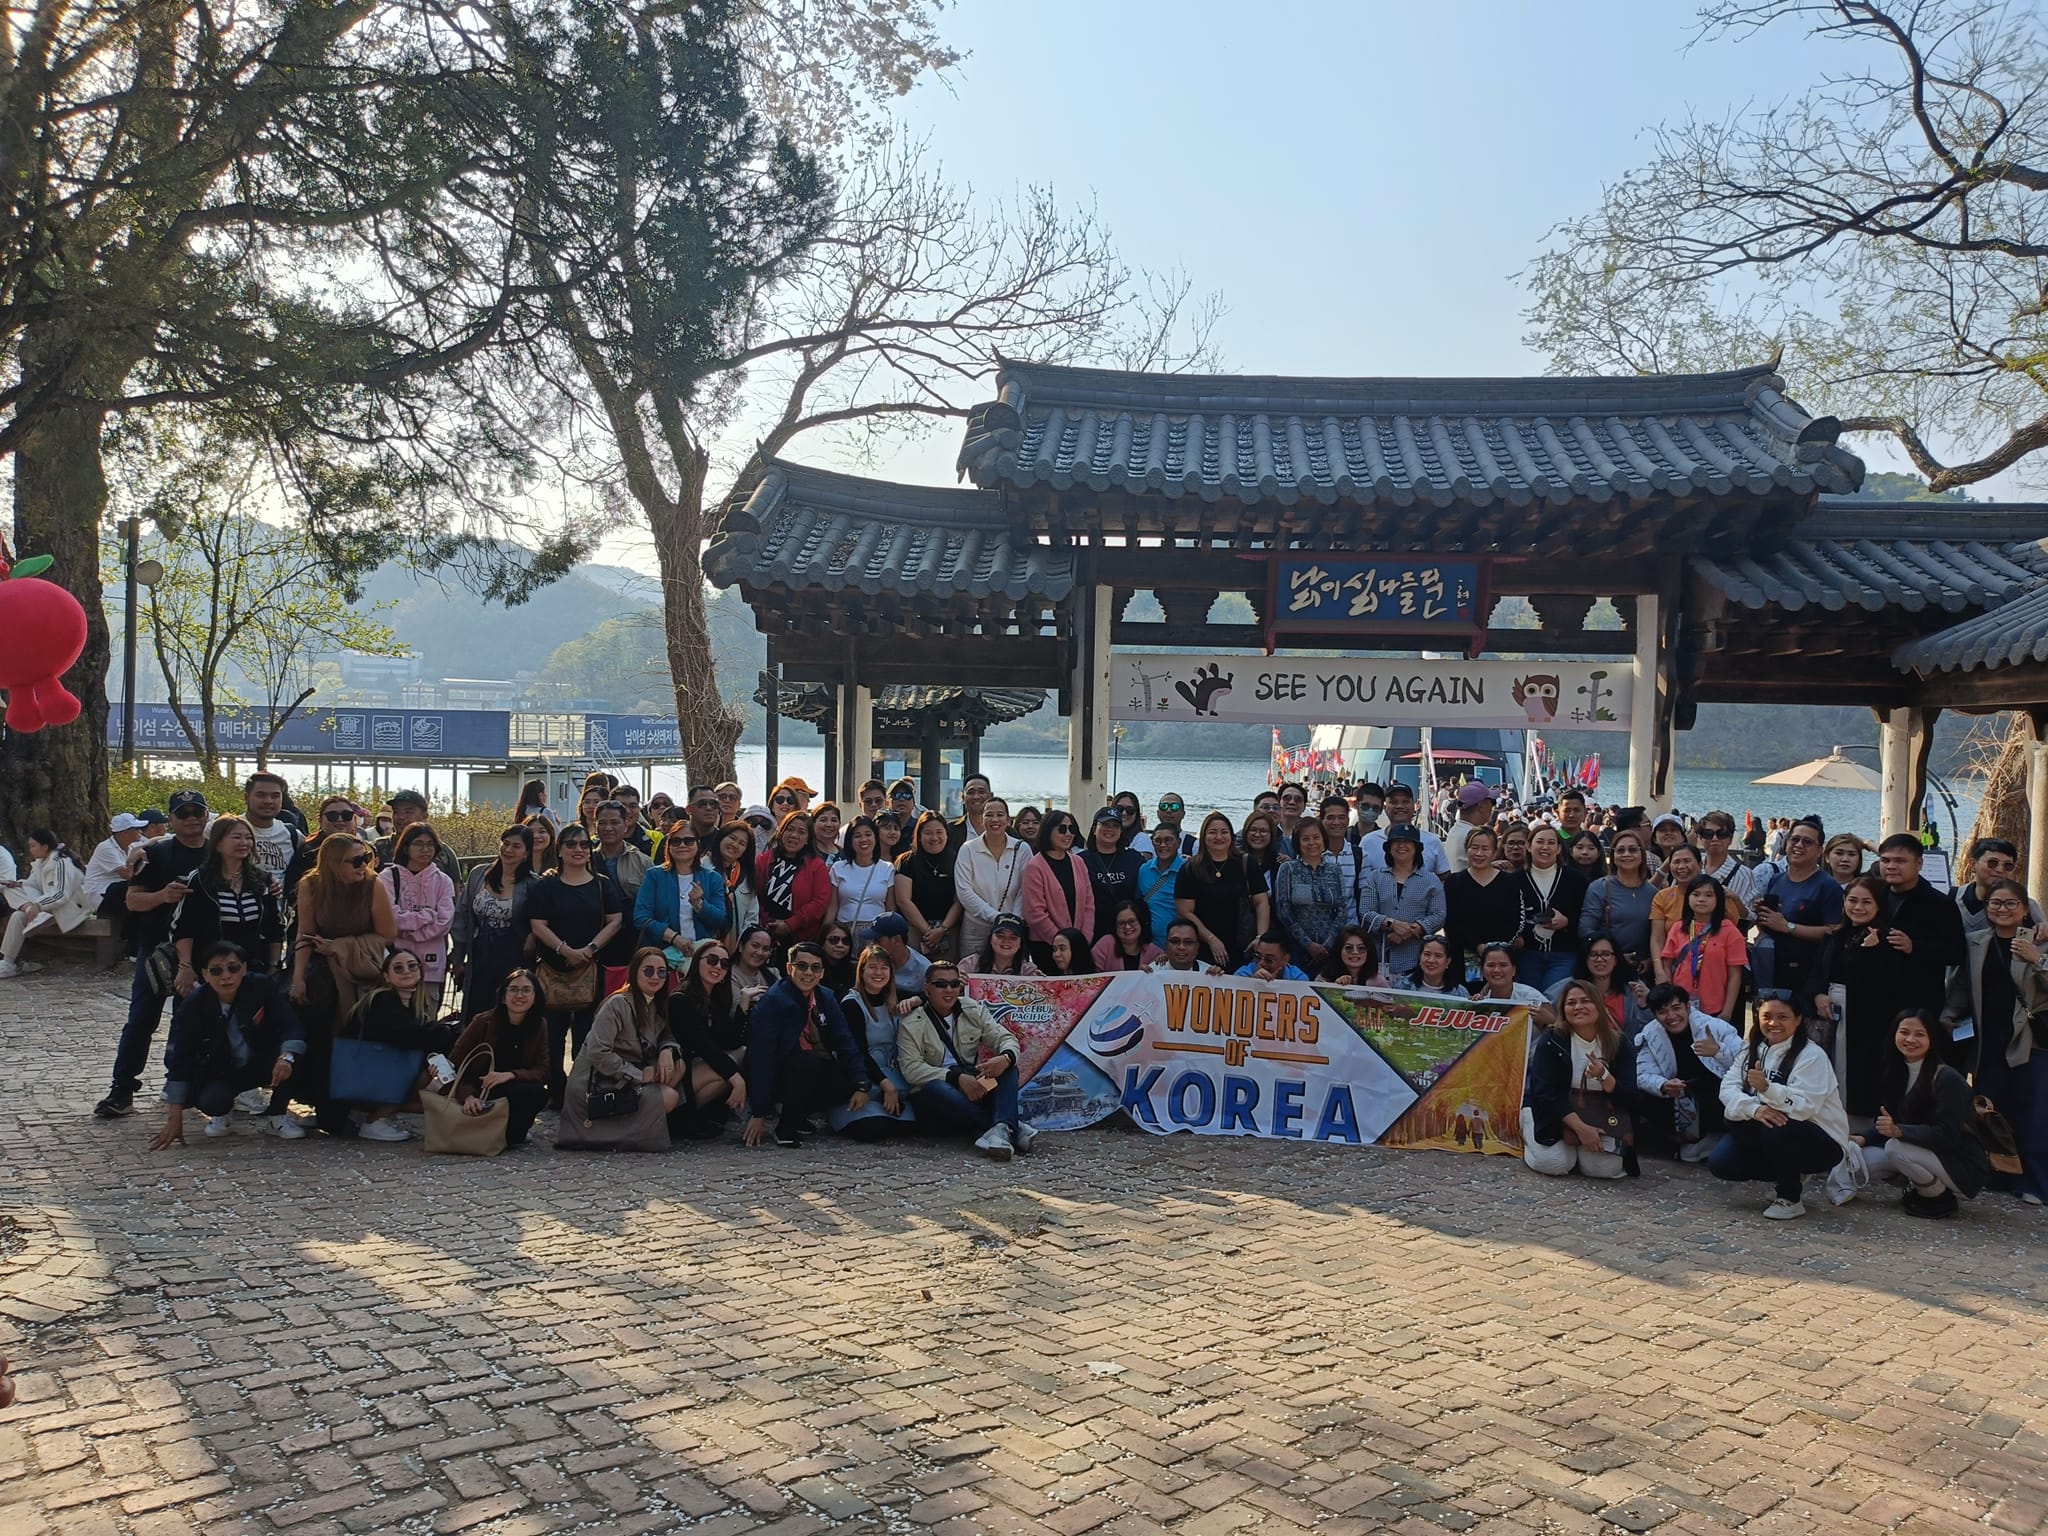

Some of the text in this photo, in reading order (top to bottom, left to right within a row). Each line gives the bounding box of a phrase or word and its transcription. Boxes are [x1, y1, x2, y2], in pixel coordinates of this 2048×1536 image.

[1255, 673, 1485, 705] SEE YOU AGAIN
[1011, 1011, 1050, 1022] PACIFIC
[1023, 1004, 1051, 1013] CEBU
[1164, 983, 1321, 1044] WONDERS
[1224, 1038, 1250, 1067] OF
[1120, 1064, 1362, 1144] KOREA
